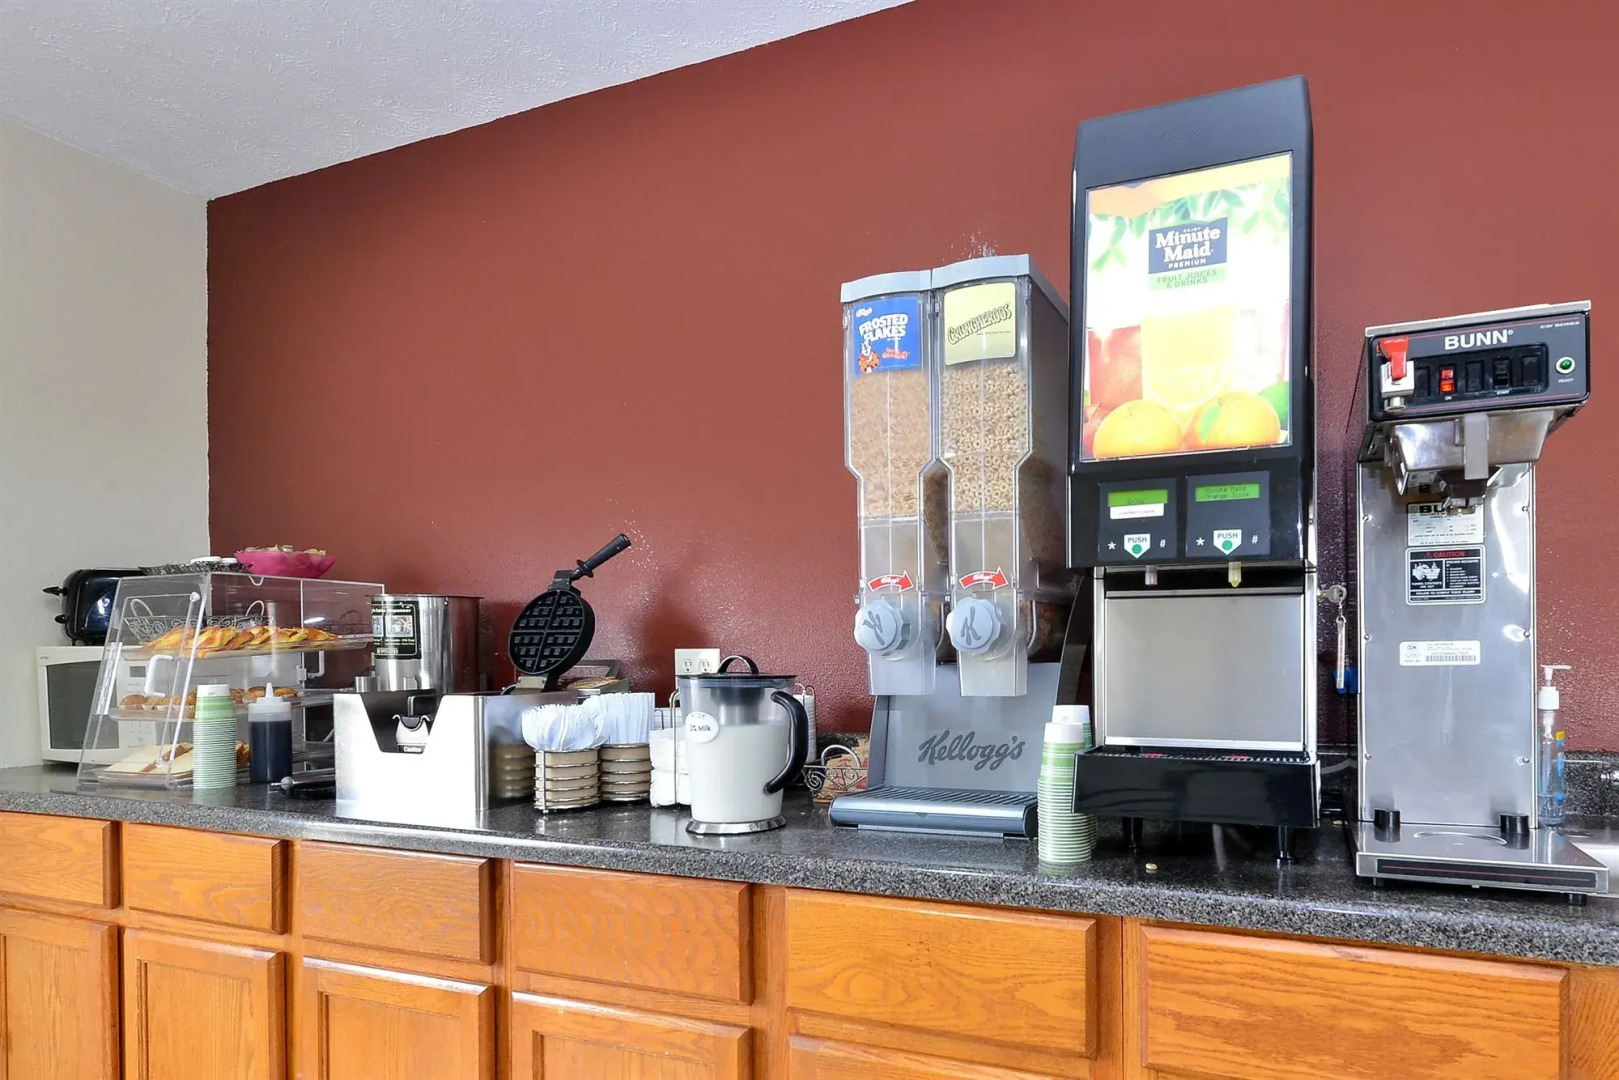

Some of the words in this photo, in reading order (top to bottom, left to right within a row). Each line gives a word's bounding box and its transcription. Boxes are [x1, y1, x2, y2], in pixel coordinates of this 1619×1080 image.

[1155, 226, 1221, 249] Minute
[1163, 241, 1212, 263] Maid
[1168, 258, 1207, 269] PREMIUM
[1157, 273, 1182, 284] FRUIT
[1187, 269, 1217, 280] JUICES
[1174, 277, 1208, 288] DRINKS
[858, 313, 909, 336] FROSTED
[863, 325, 906, 343] FLAKES
[947, 303, 1013, 345] CRUNCHEROOS
[1444, 329, 1509, 351] BUNN
[918, 729, 1026, 771] Kellogg's
